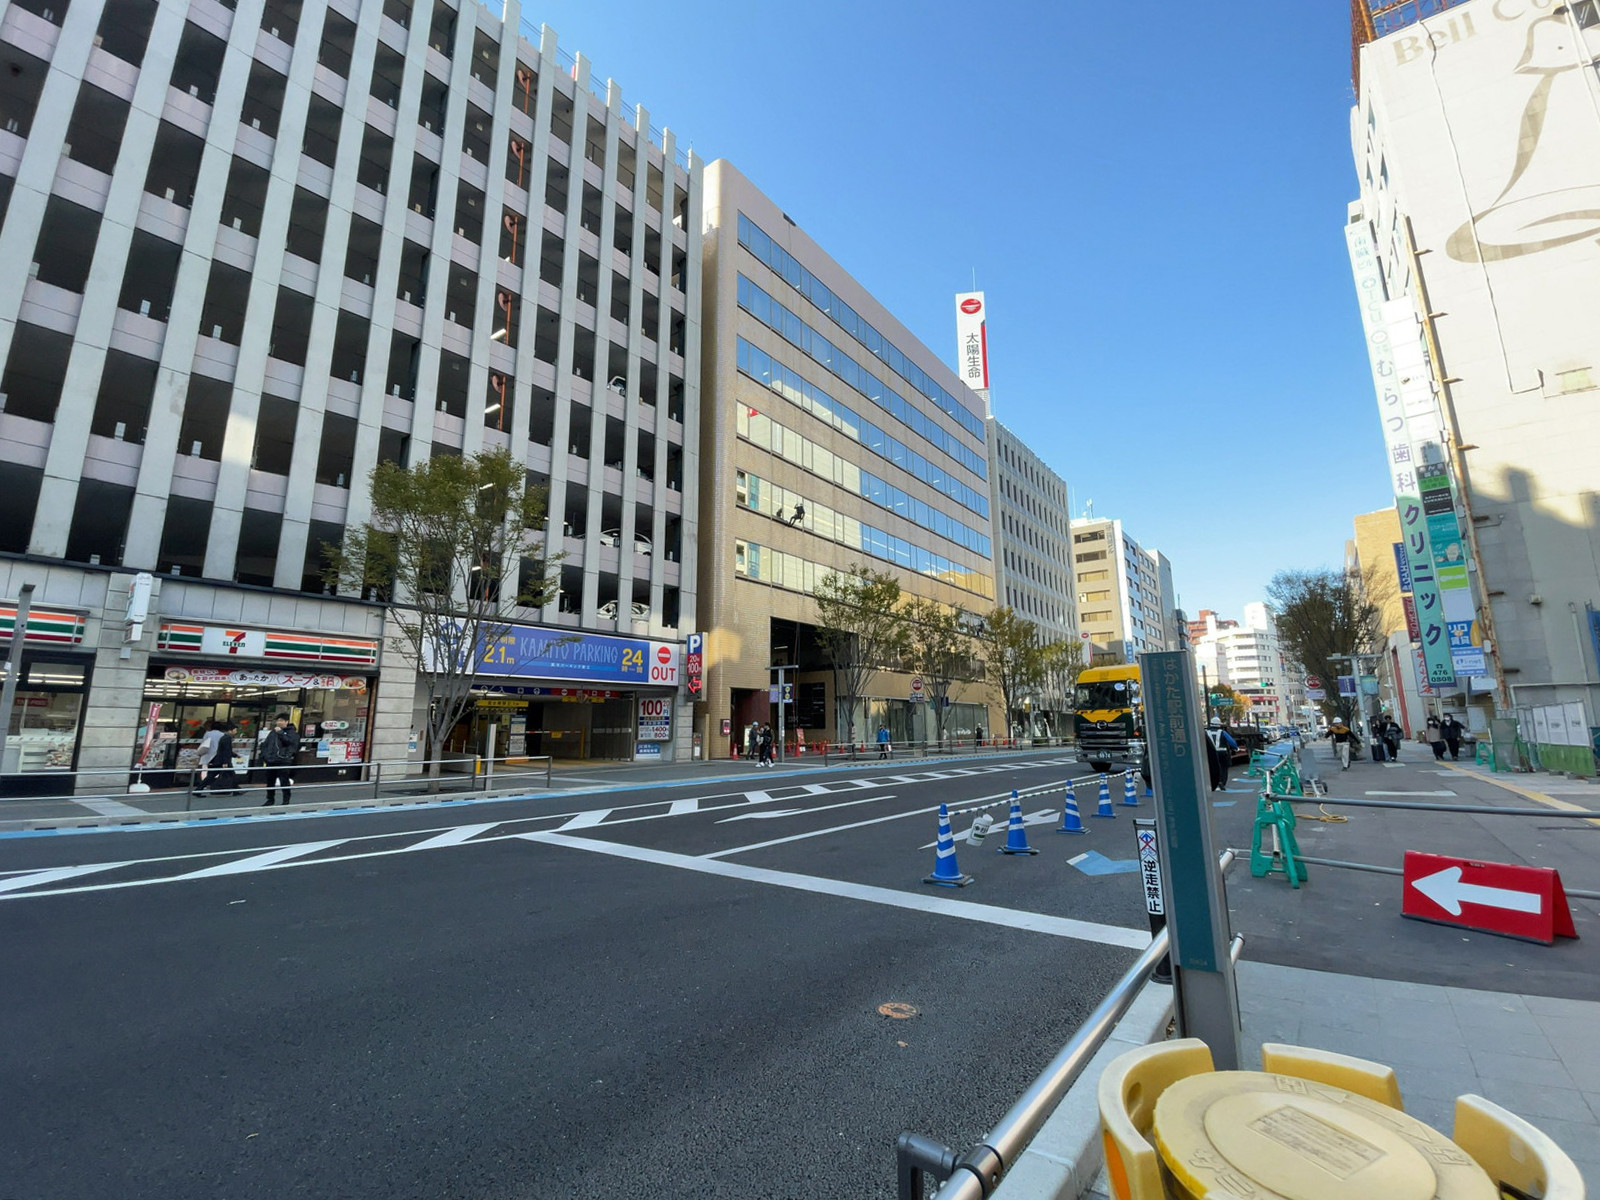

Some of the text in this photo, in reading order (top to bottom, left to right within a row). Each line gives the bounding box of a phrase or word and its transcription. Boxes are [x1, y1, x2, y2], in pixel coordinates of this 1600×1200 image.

[1391, 11, 1478, 66] Bell
[966, 332, 981, 379] 太陽生命
[1375, 358, 1442, 647] むらつ歯科クリニック
[573, 643, 619, 664] PARKING
[689, 635, 701, 654] P
[483, 645, 515, 665] 2.1m
[622, 647, 643, 667] 24
[239, 672, 270, 683] あったか
[651, 665, 676, 682] OUT
[640, 699, 663, 716] 100
[1163, 656, 1188, 758] はかた駅前通り
[1142, 859, 1163, 914] 逆走禁止
